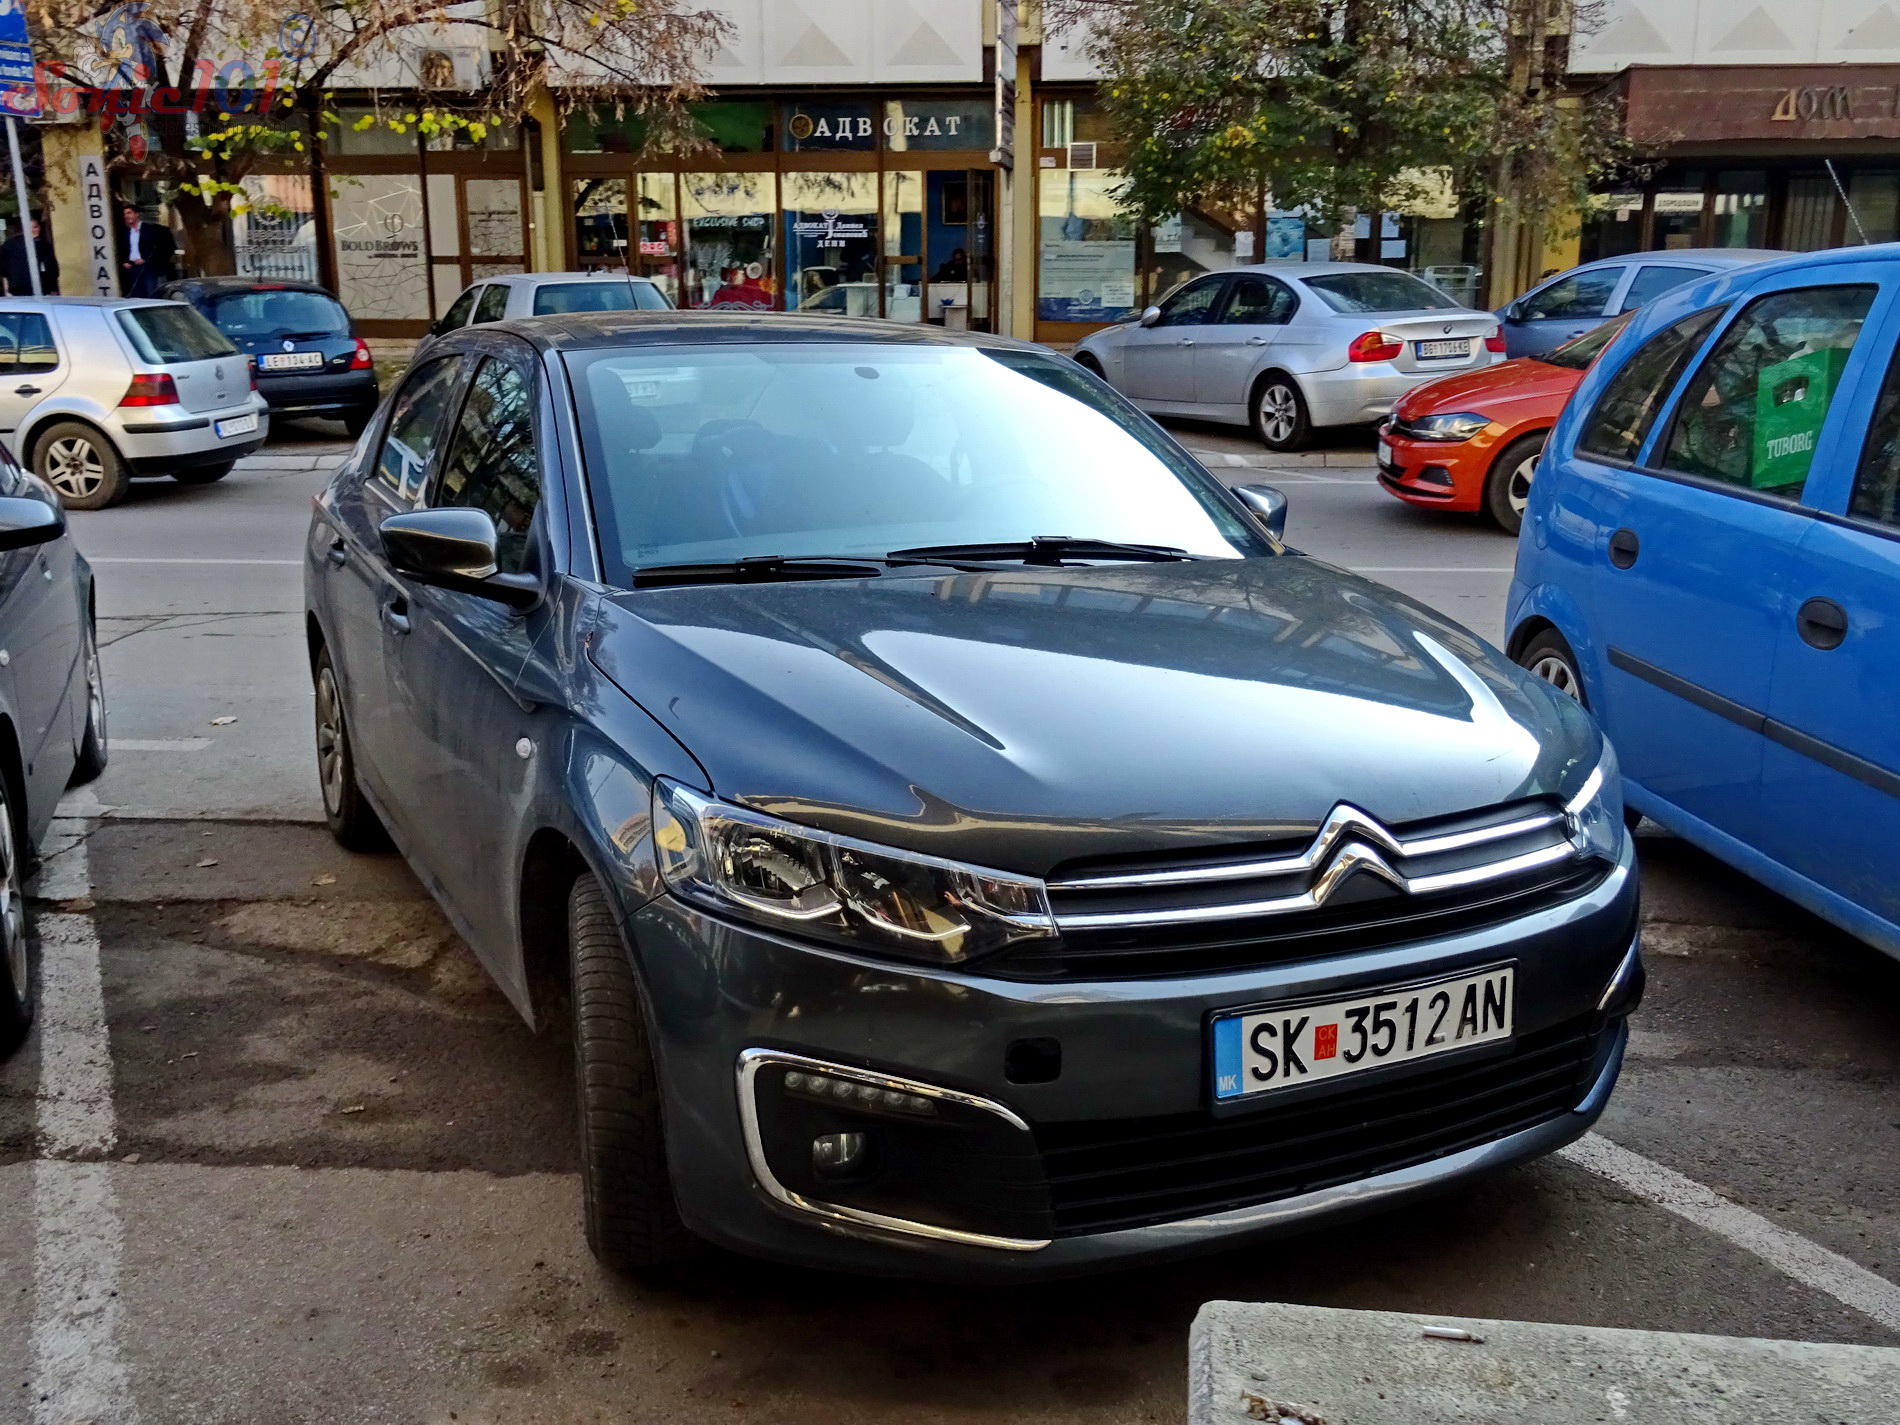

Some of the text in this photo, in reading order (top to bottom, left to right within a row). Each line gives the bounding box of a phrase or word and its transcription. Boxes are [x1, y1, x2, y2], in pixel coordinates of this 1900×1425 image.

[814, 116, 961, 141] АДВОКАТ
[85, 162, 112, 297] АДВОКАТ
[341, 240, 373, 251] BOLD
[1766, 430, 1814, 460] TUBORG
[1250, 1016, 1310, 1082] SK
[1218, 1075, 1238, 1093] MK
